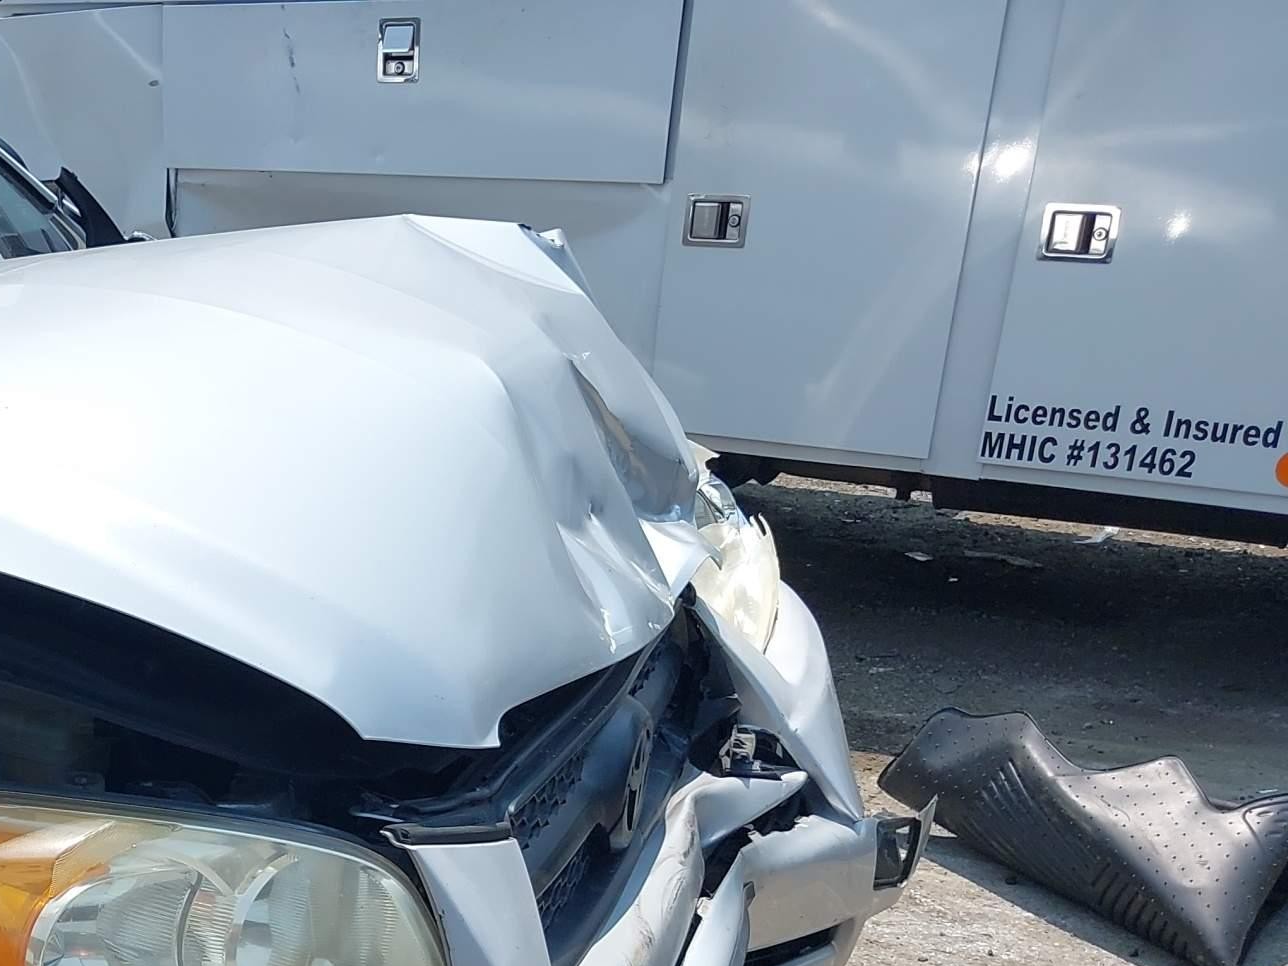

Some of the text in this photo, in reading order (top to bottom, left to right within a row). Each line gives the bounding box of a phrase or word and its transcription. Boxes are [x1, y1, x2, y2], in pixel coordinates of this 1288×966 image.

[987, 394, 1284, 449] Licensed & Insured
[980, 431, 1196, 479] MHIC #131462
